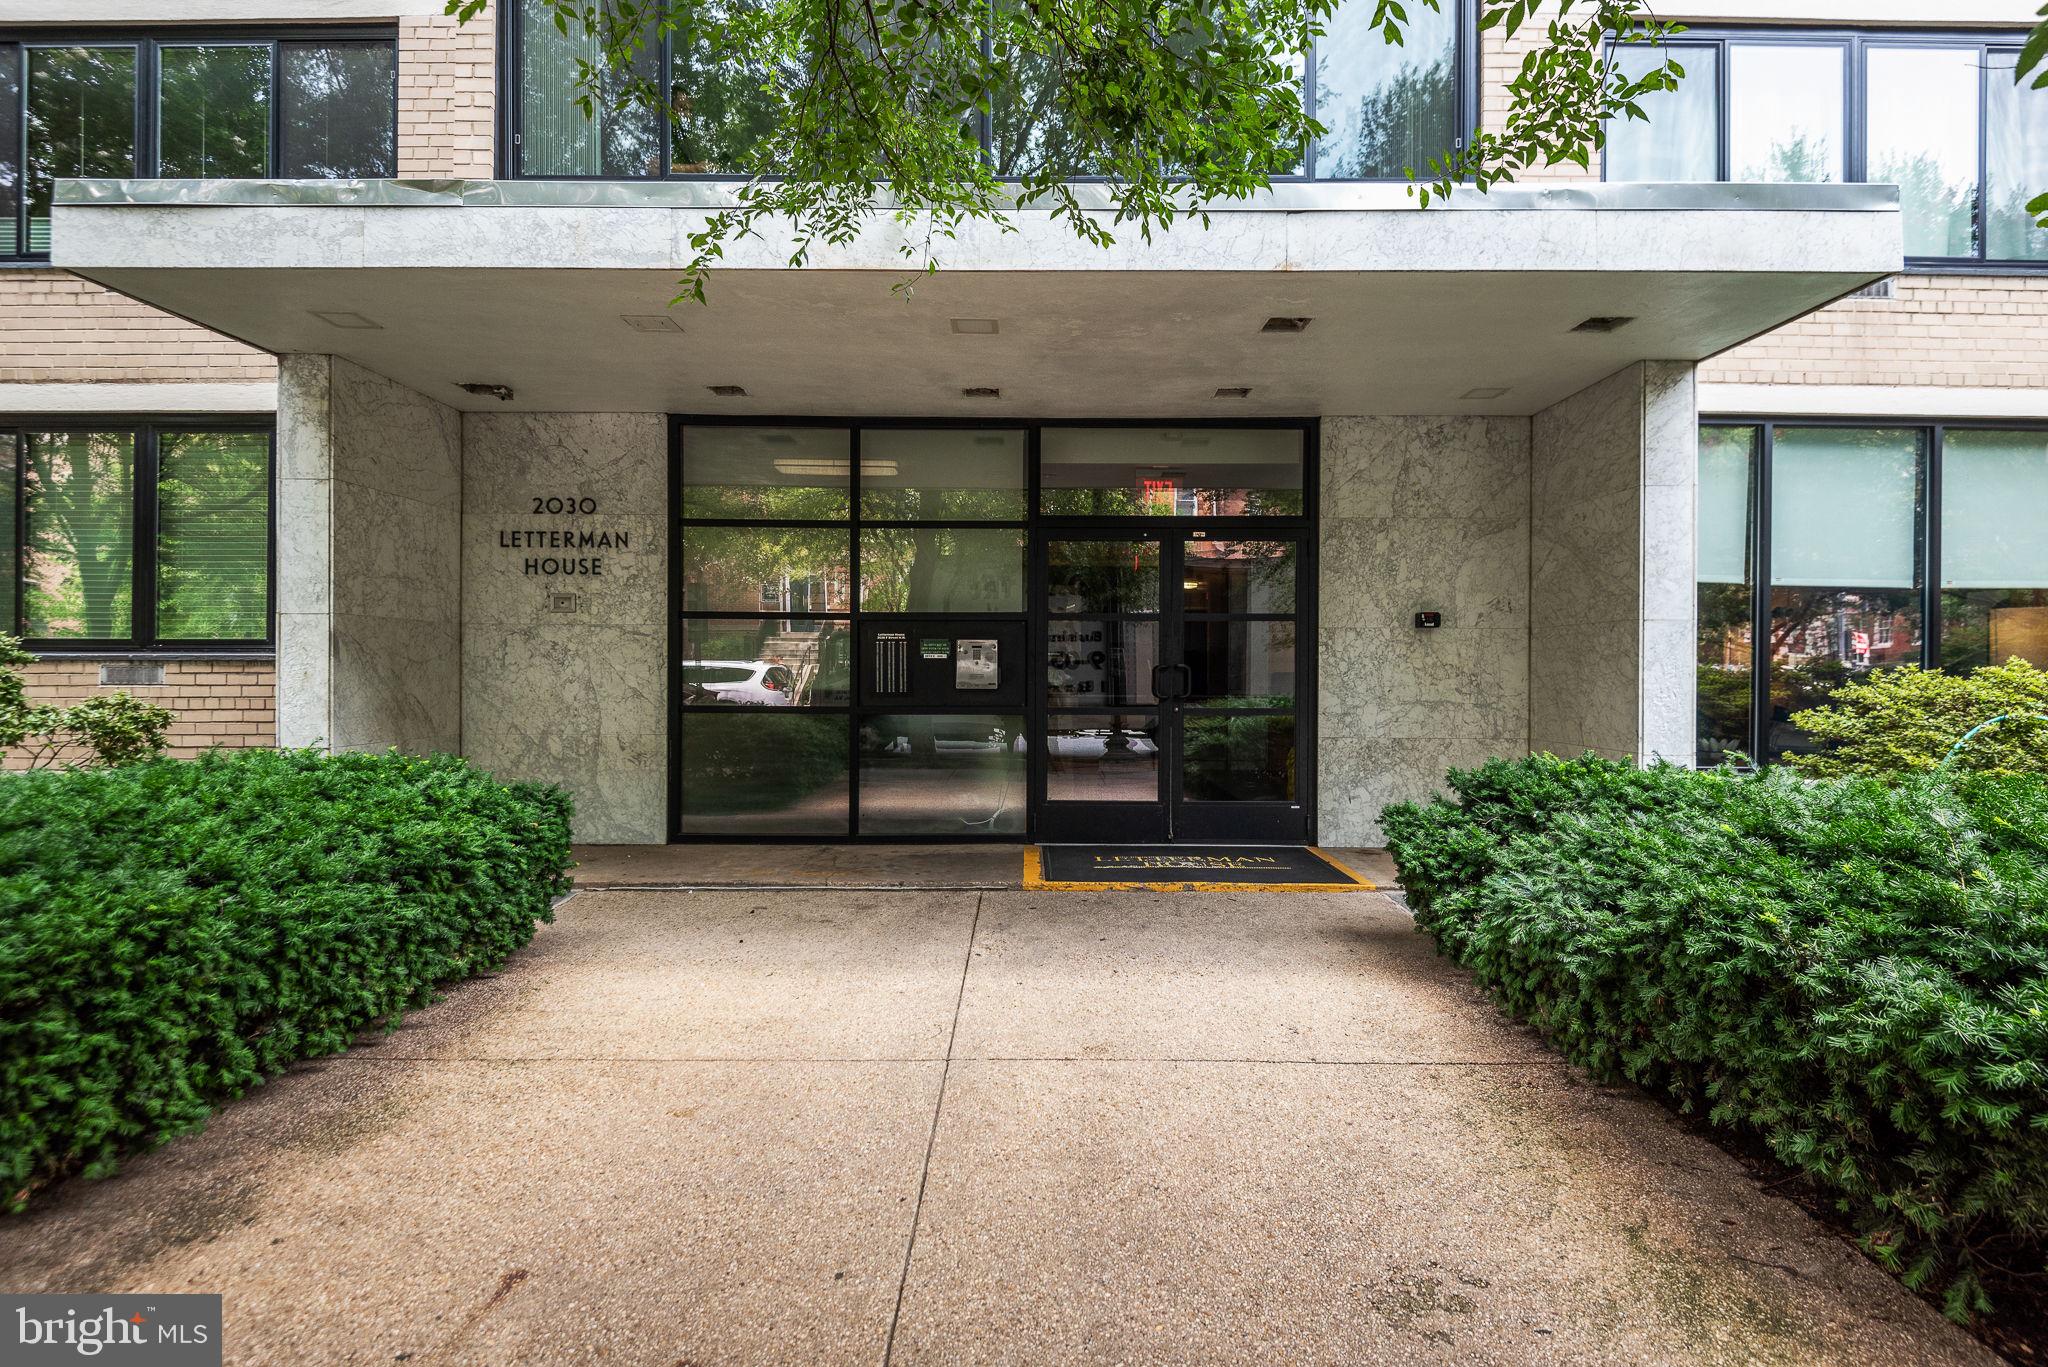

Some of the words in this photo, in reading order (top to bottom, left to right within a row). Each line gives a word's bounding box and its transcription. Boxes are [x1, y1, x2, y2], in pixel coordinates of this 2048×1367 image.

[532, 497, 597, 515] 2030
[500, 531, 629, 548] LETTERMAN
[525, 558, 602, 575] HOUSE
